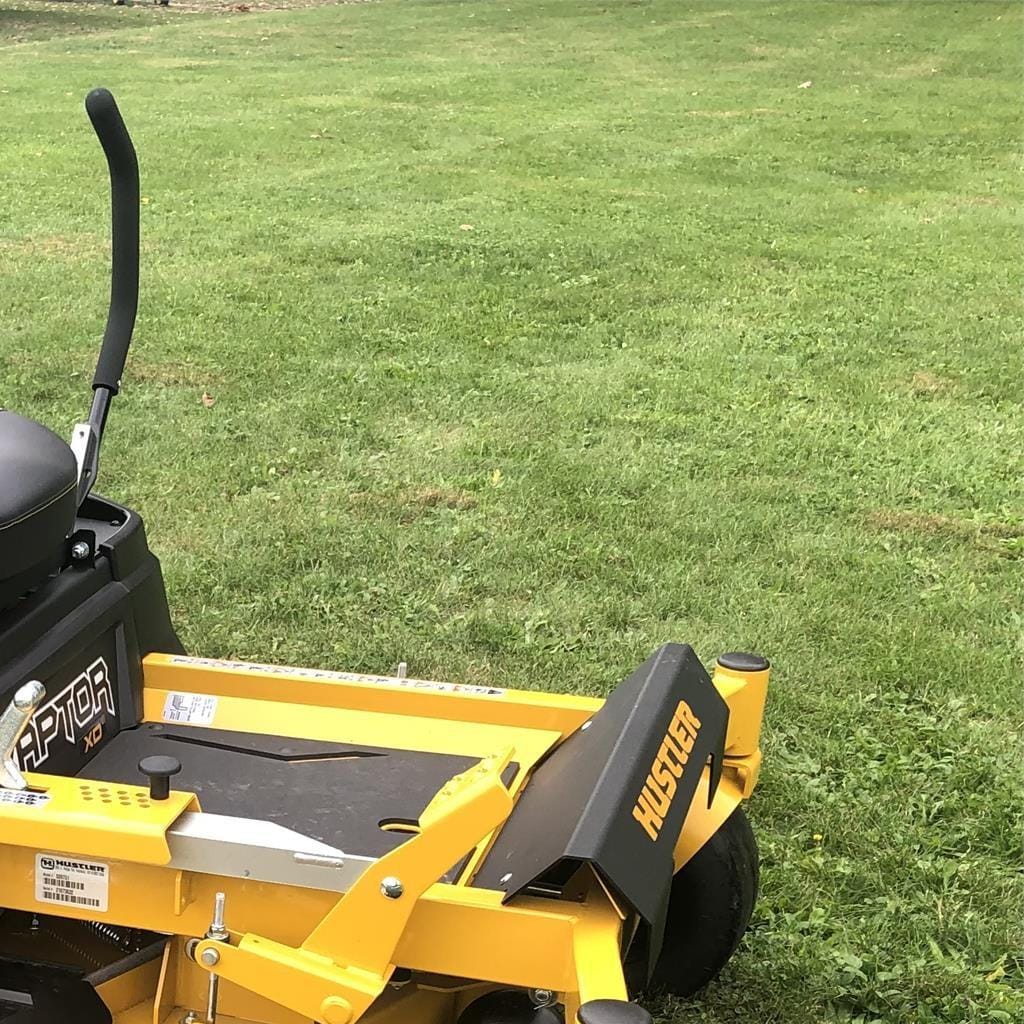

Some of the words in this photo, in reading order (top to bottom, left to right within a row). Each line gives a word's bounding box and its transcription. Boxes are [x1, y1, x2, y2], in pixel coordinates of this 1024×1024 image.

[11, 656, 116, 772] APTOR
[632, 700, 702, 842] HUSTLER
[56, 860, 105, 873] HUSTLER
